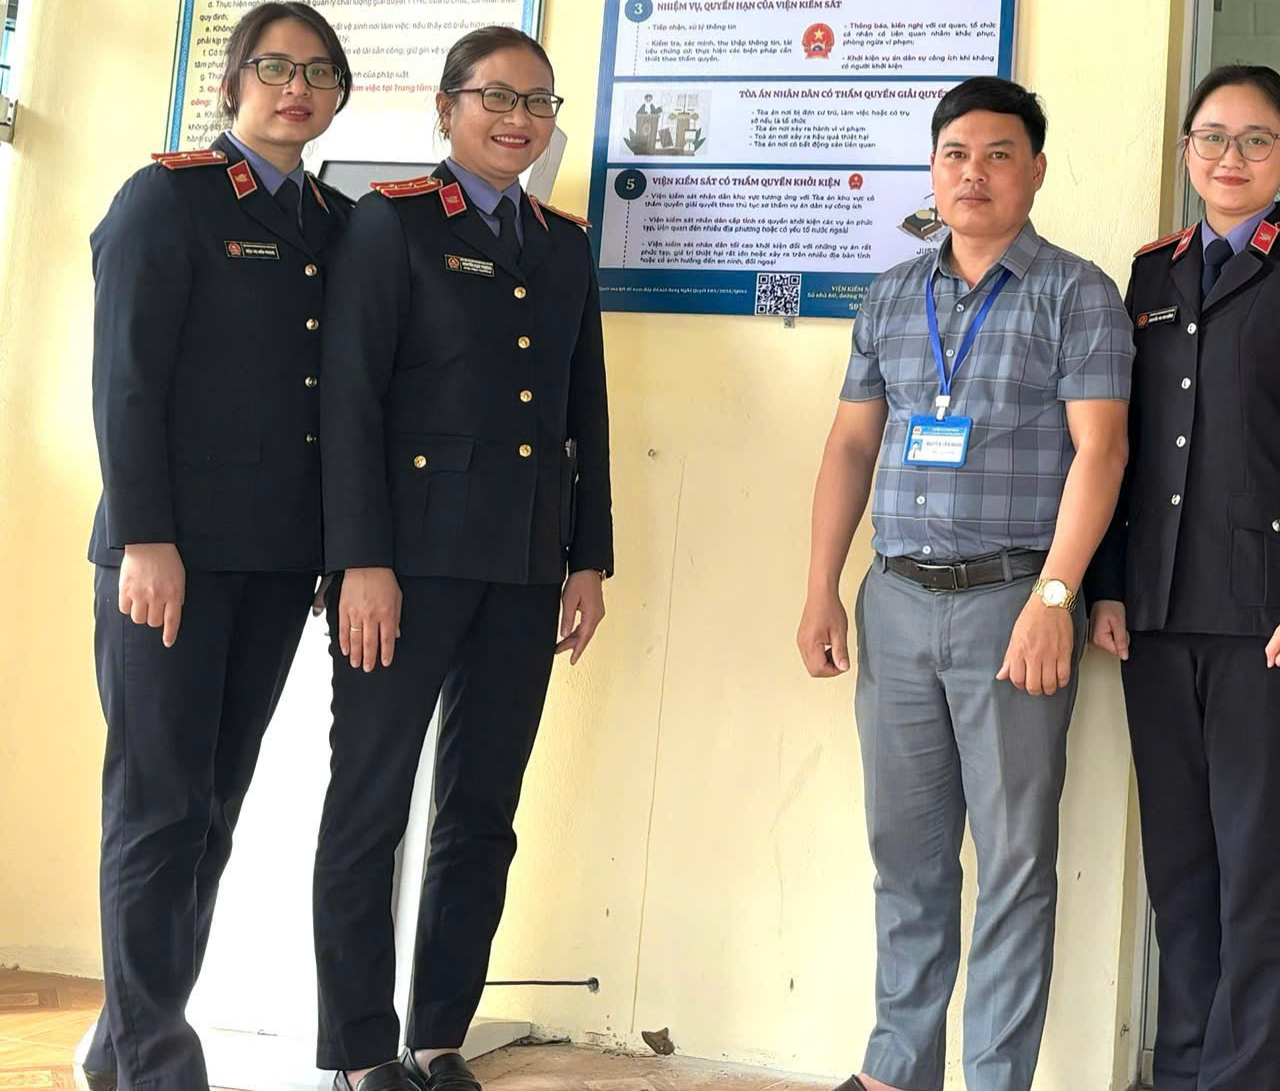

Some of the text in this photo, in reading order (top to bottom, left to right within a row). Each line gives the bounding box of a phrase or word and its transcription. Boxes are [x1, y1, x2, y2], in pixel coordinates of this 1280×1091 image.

[634, 3, 643, 14] 3
[657, 0, 687, 12] NHIỆM
[688, 2, 702, 12] VỤ,
[703, 0, 734, 11] QUYỀN
[735, 1, 755, 11] HẠN
[775, 0, 797, 10] VIỆN
[738, 88, 756, 98] TÒA
[758, 88, 771, 98] ÁN
[773, 89, 799, 98] NHÂN
[800, 89, 819, 98] DÂN
[820, 88, 833, 98] CÓ
[834, 88, 862, 98] THẨM
[863, 89, 895, 99] QUYỀN
[897, 88, 916, 98] GIẢI
[626, 176, 840, 190] 5 VIỆN KIỂM SÁT CÓ THẨM QUYỀN KHỞI KIỆN
